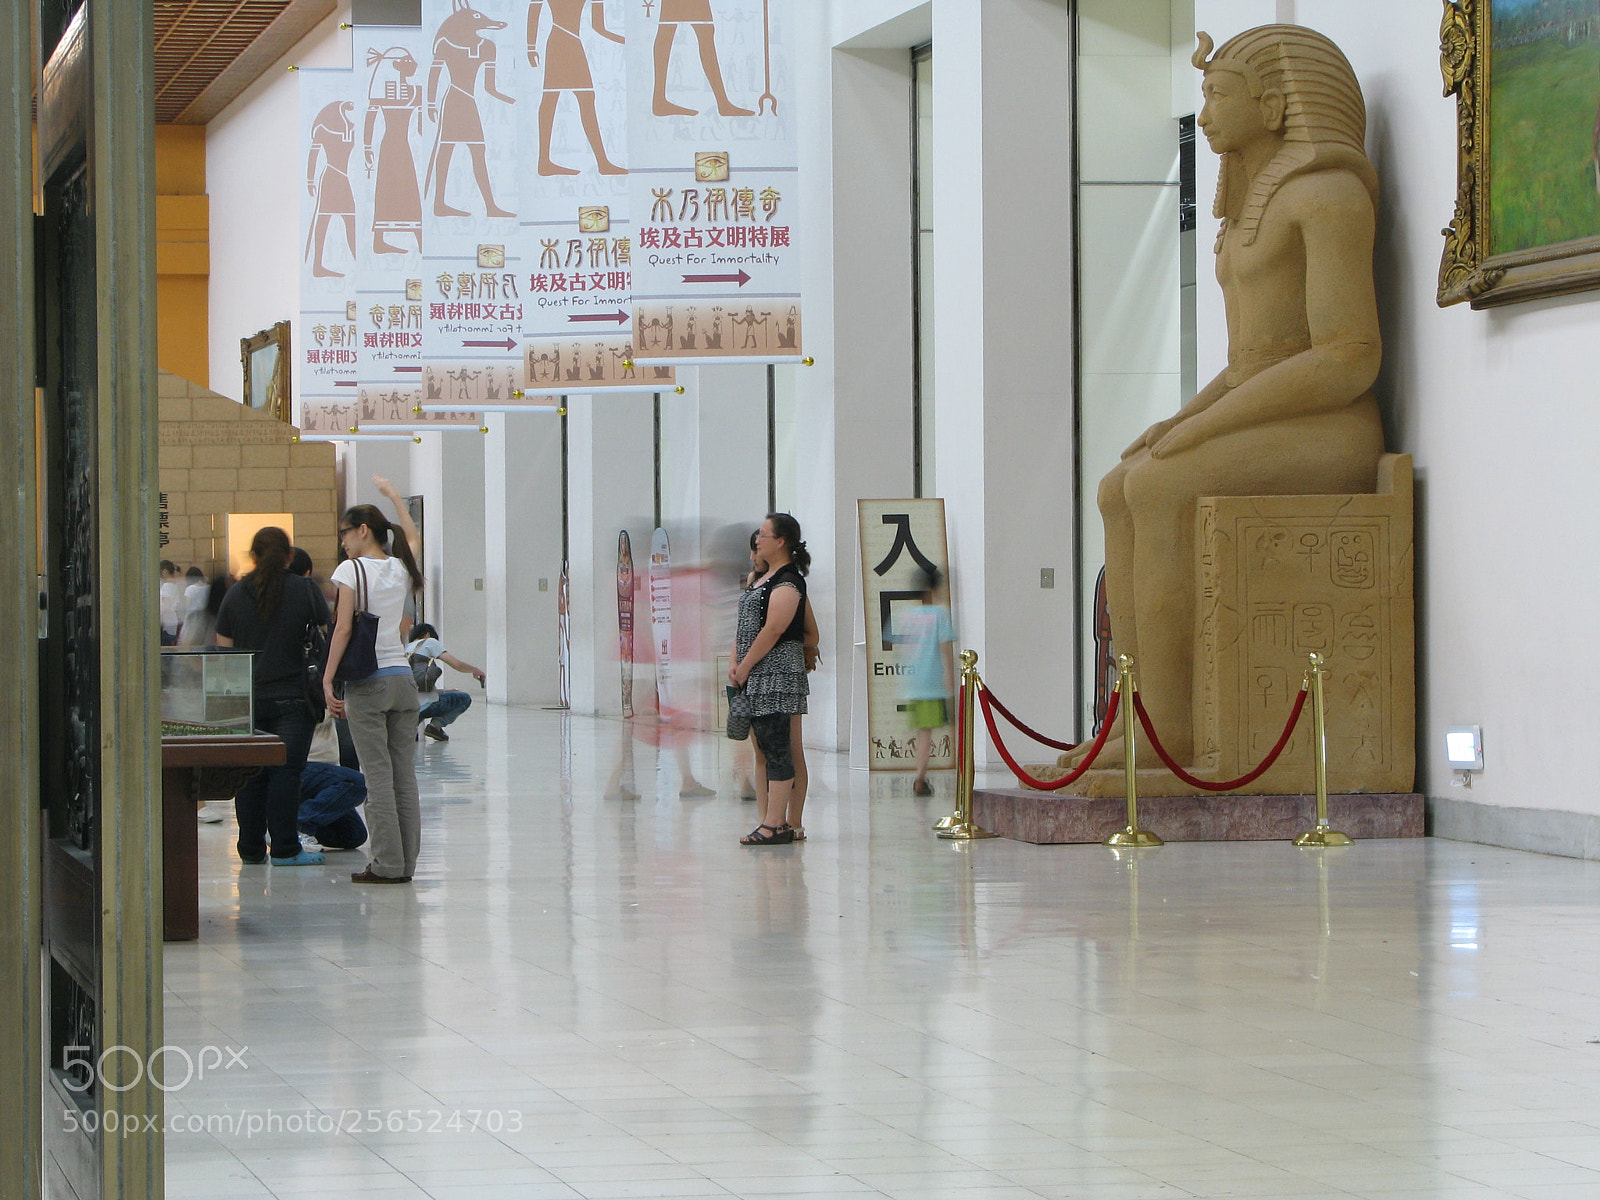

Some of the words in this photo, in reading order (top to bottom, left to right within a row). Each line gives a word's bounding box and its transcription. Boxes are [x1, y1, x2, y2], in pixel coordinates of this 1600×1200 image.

[650, 186, 781, 222] 木乃伊傳奇
[639, 225, 790, 249] 埃及古文明特展
[539, 236, 631, 269] 木乃伊傳
[648, 253, 683, 267] Quest
[686, 253, 707, 265] For
[711, 252, 780, 265] Immortality
[529, 271, 631, 293] 埃及古文明
[537, 296, 568, 308] Quest
[571, 296, 590, 306] For
